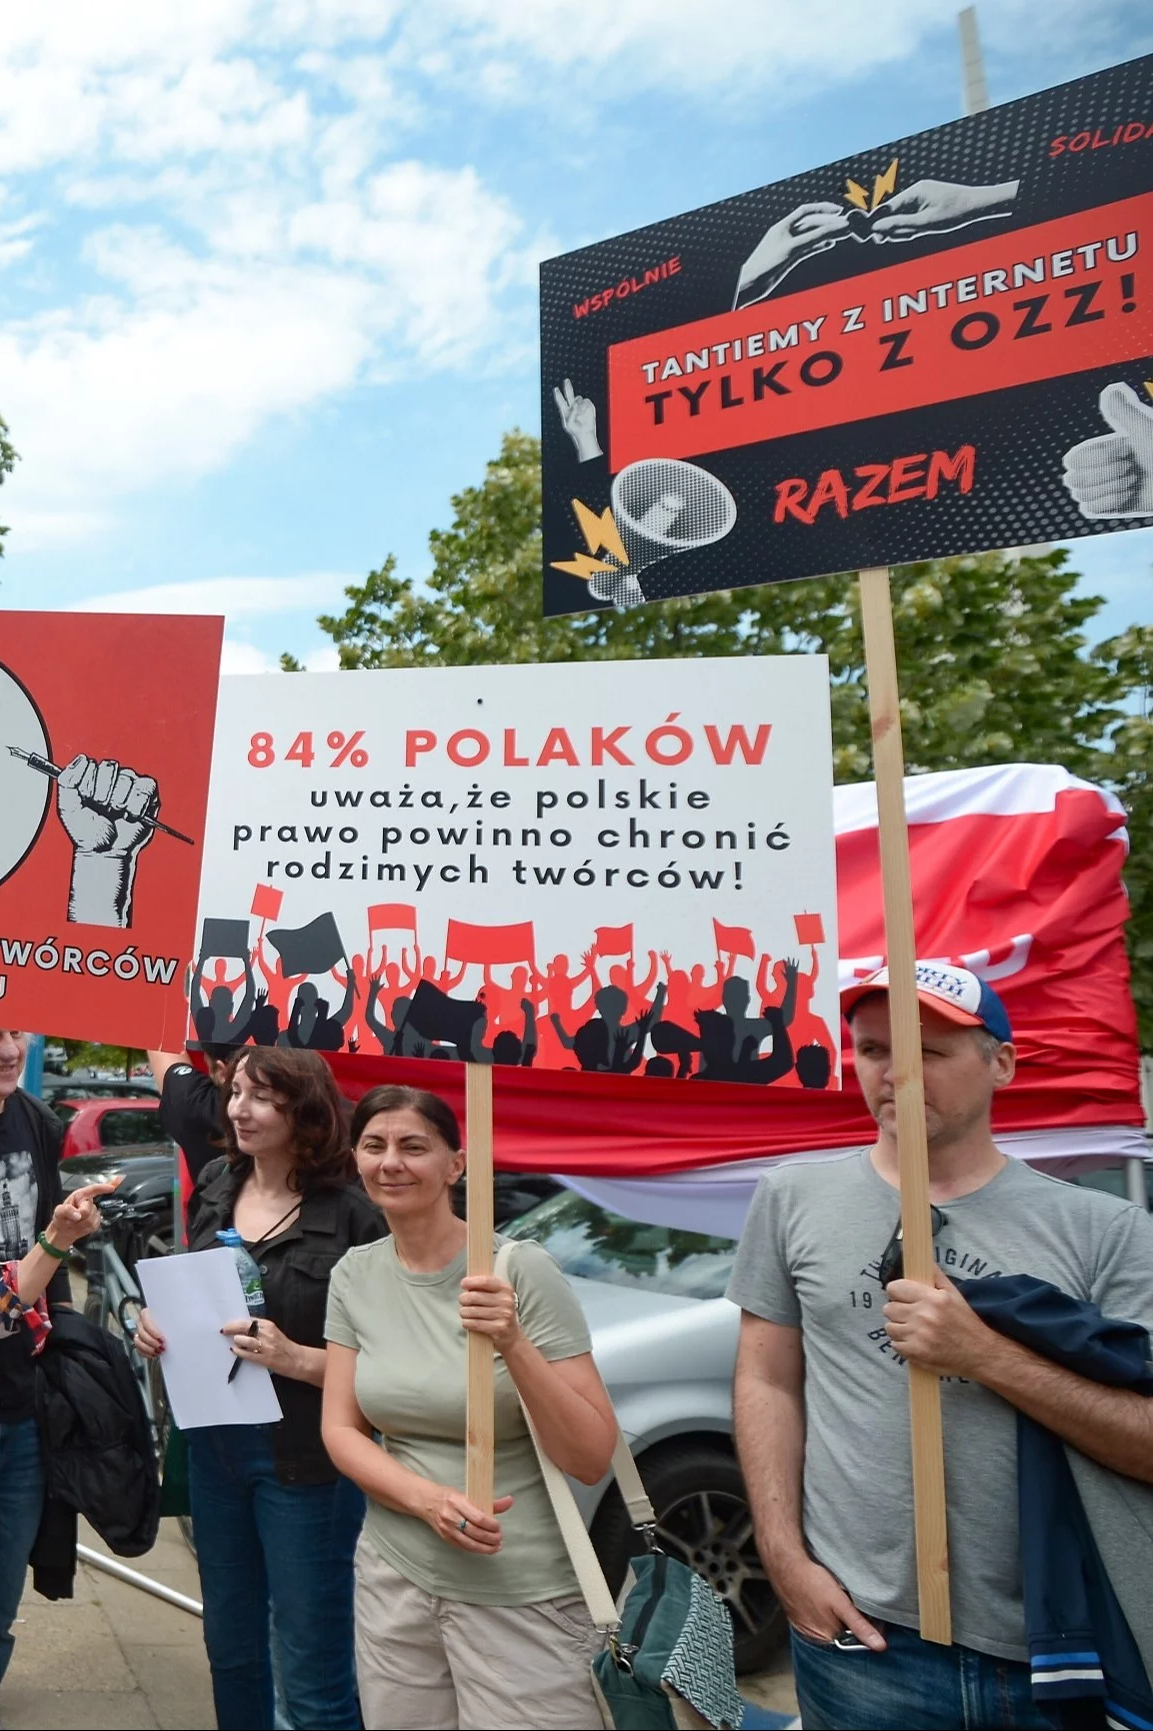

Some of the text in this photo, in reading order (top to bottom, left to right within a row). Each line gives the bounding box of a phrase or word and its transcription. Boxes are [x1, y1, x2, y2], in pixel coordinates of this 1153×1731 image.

[574, 256, 683, 321] WSPÓLNIE
[641, 231, 1139, 384] TANTIEMY Z INTERNETU
[645, 273, 1137, 426] TYLKO Z OZZ!
[773, 445, 975, 525] RAZEM
[247, 712, 773, 769] 84% POLAKÓW
[310, 779, 712, 818] uważa,że polskie
[233, 818, 792, 854] prawo powinno chronić
[266, 852, 744, 892] rodzimych twórców!
